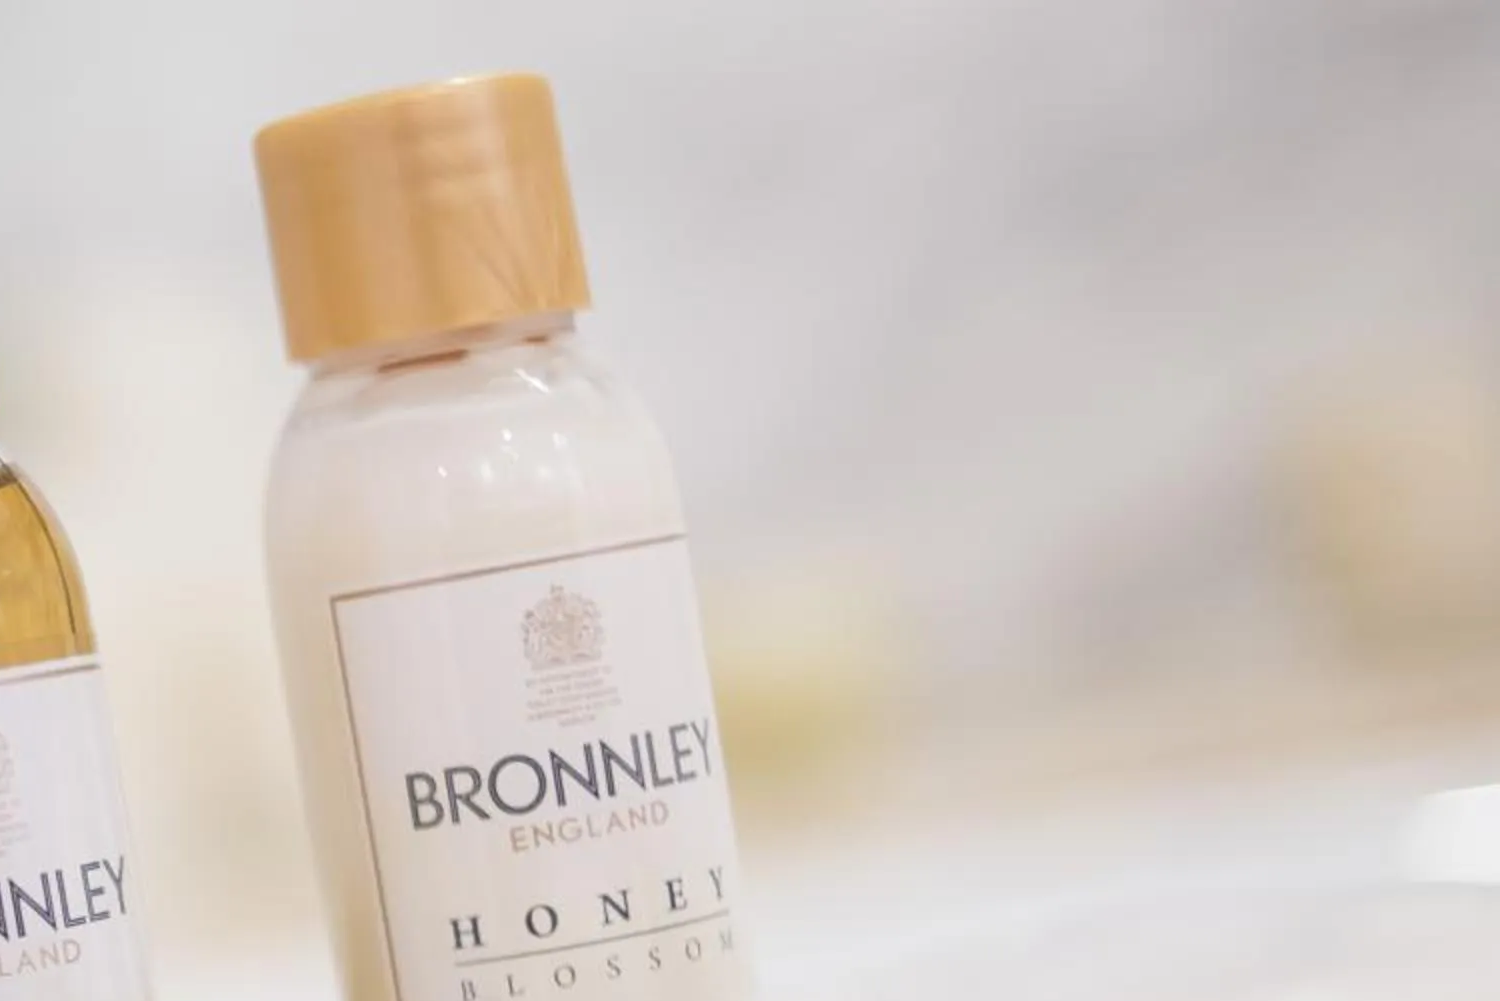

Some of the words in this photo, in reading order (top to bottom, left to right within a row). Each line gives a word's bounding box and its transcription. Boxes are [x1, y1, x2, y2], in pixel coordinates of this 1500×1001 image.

[405, 718, 712, 831] BRONNLEY
[510, 800, 669, 853] ENGLAND
[449, 866, 725, 950] HONEY
